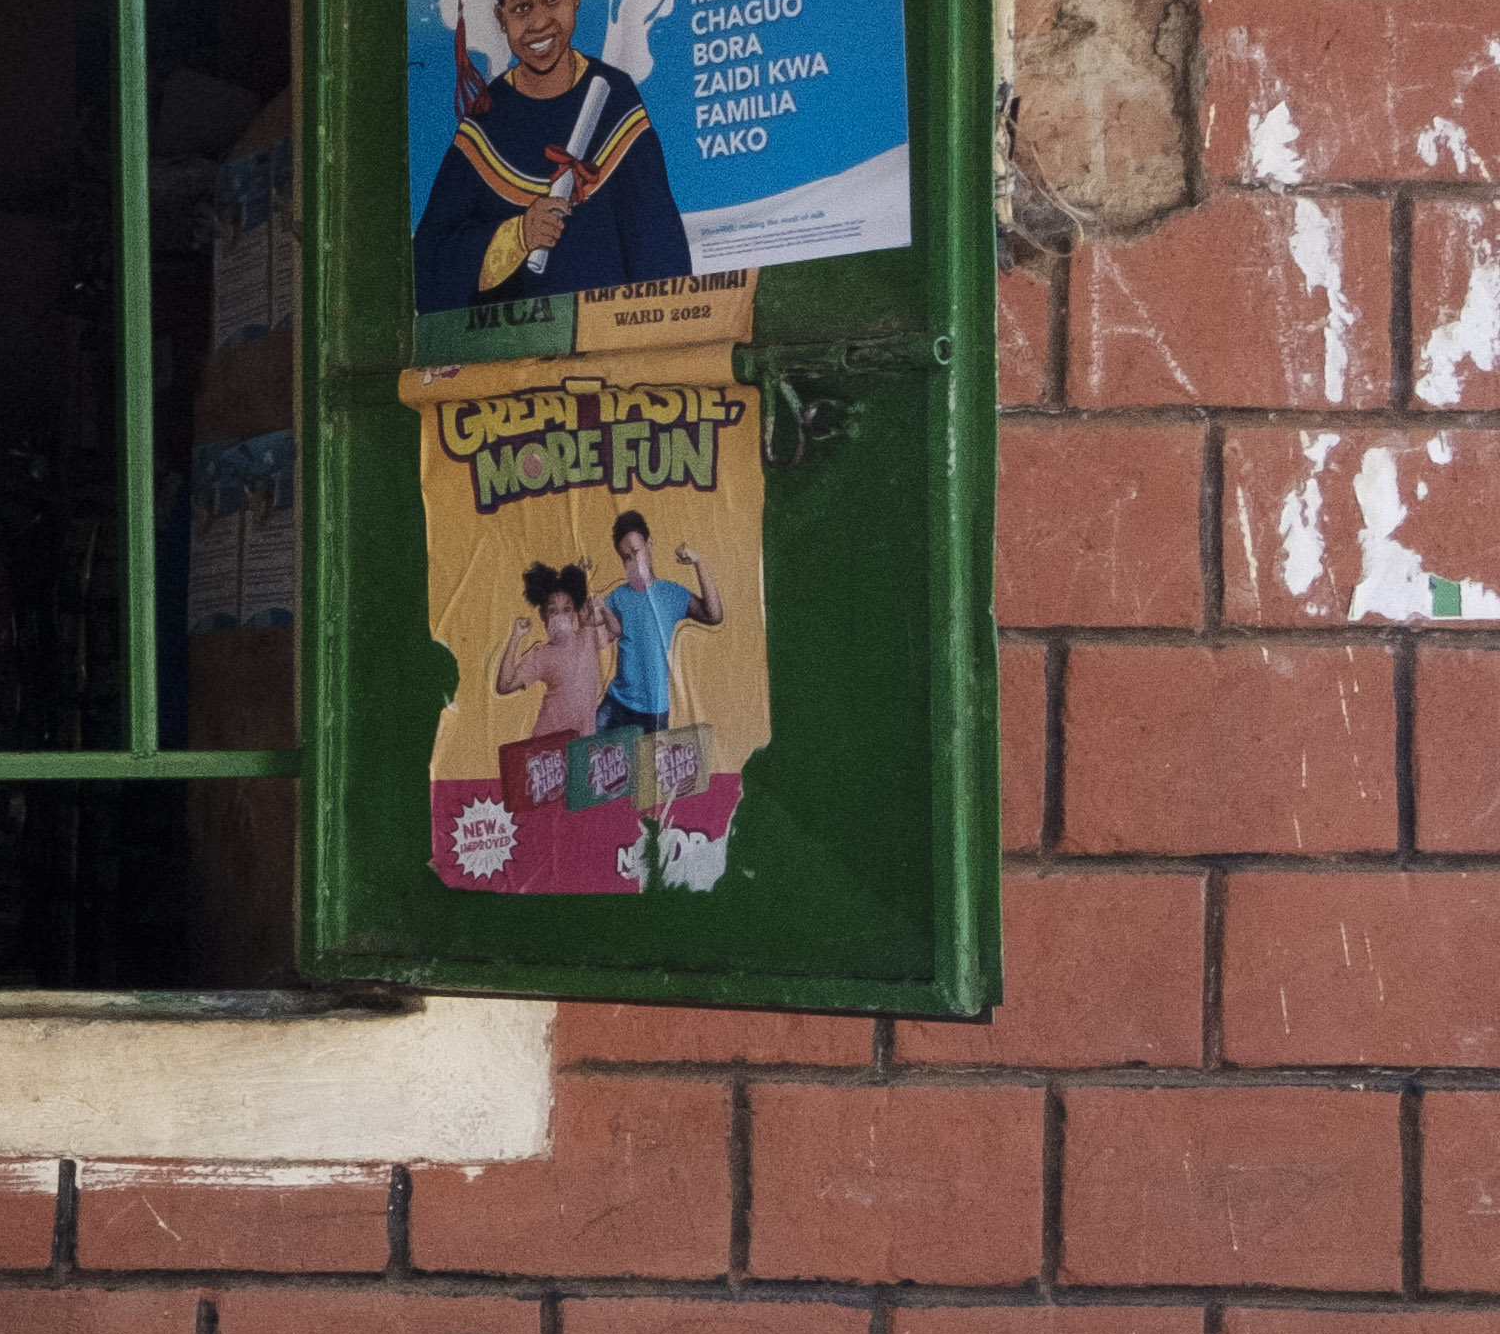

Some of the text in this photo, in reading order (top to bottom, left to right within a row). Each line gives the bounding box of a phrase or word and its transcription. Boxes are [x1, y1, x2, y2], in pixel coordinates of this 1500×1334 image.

[692, 32, 764, 67] BORA
[693, 51, 830, 98] ZAIDI KWA
[695, 89, 798, 129] FAMILIA
[696, 125, 769, 160] YAKO
[614, 304, 713, 327] WARD 2022
[442, 389, 580, 456] GREAT
[475, 420, 716, 507] MORE FUN
[459, 834, 513, 855] IMPROVED
[462, 819, 498, 840] NEW
